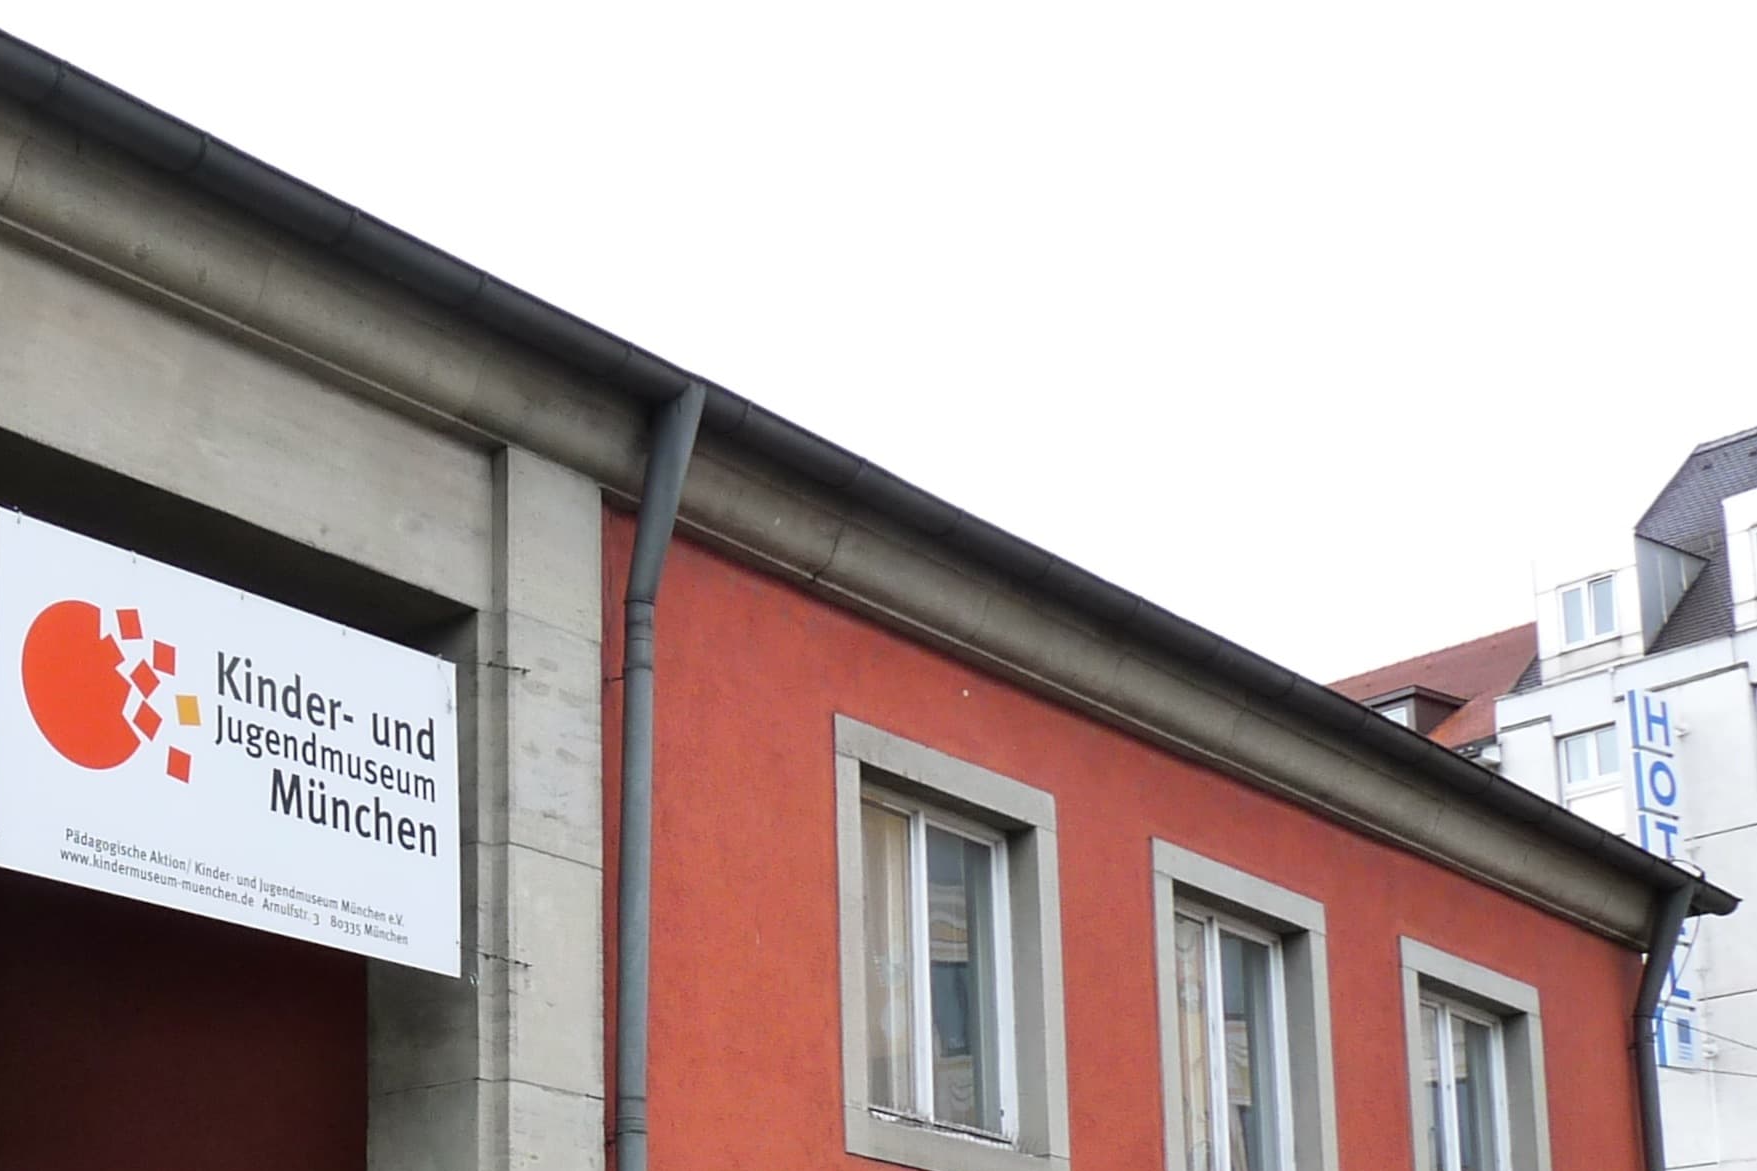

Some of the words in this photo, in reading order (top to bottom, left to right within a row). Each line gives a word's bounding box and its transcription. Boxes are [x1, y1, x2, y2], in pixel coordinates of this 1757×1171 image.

[214, 704, 436, 803] Jugendmuseum
[217, 651, 354, 731] Kinder-
[371, 712, 436, 762] und
[270, 768, 438, 857] München
[60, 849, 255, 908] www.kindermuseum-muenchen.de
[262, 898, 310, 921] Arnulfstr.
[313, 913, 320, 926] 3
[330, 915, 362, 937] 80335
[363, 922, 409, 945] München
[65, 828, 147, 861] Pädagogische
[194, 861, 235, 882] Kinder-
[237, 876, 257, 890] und
[259, 878, 339, 909] Jugendmuseum
[341, 900, 387, 922] München
[388, 914, 405, 927] e.V.
